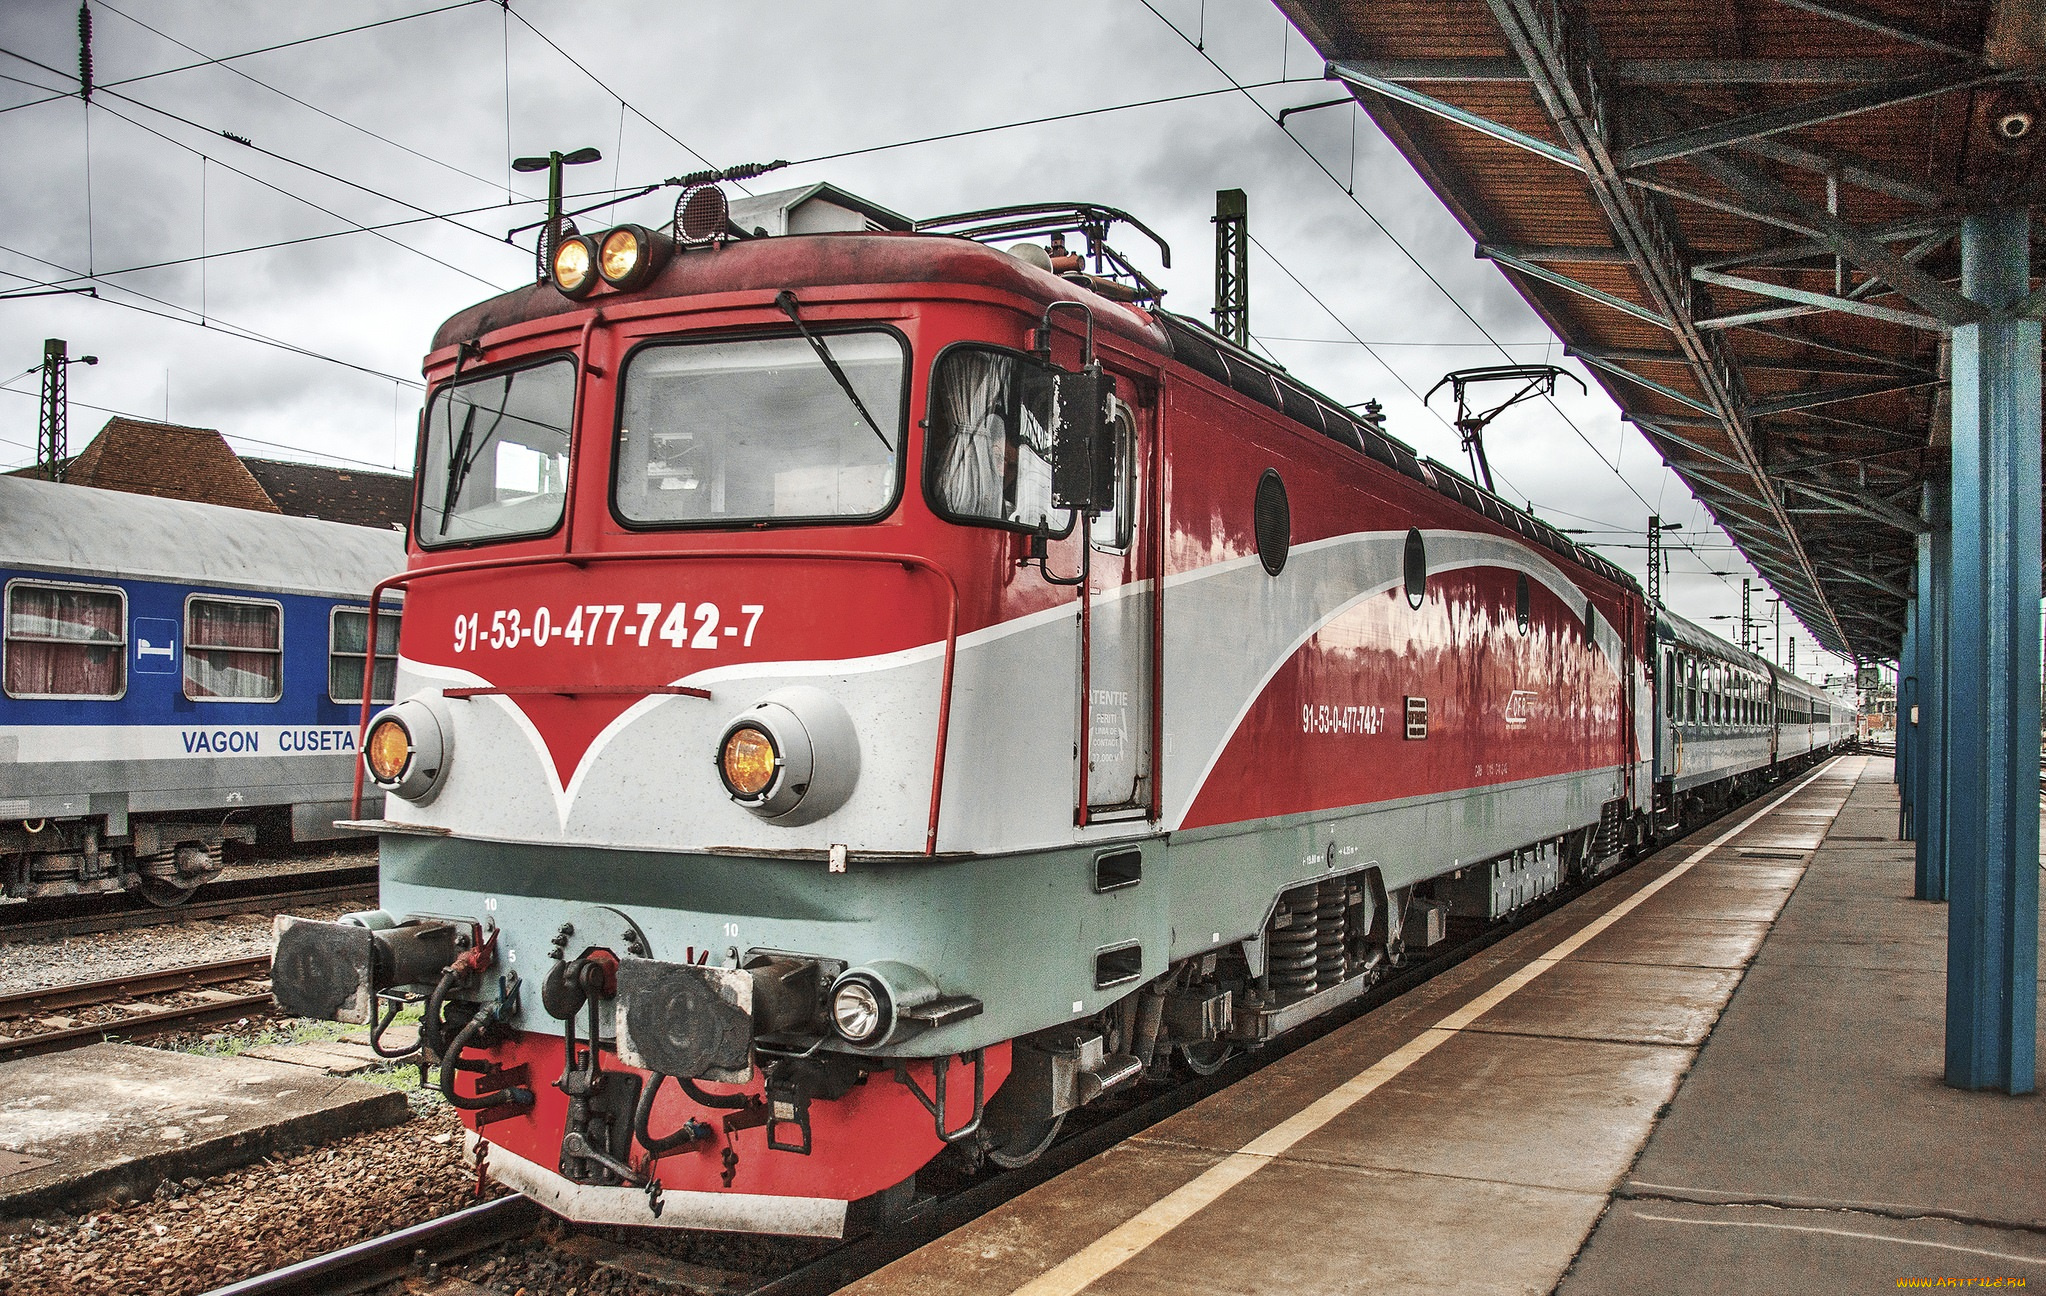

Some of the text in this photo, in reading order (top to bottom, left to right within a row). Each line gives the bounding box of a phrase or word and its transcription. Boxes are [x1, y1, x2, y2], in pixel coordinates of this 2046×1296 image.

[453, 602, 765, 653] 91-53-0-477-742-7
[1303, 703, 1384, 734] 91-53-0-477-742-7
[182, 730, 355, 753] VAGON CUSETA
[484, 898, 498, 911] 10
[723, 922, 739, 937] 10
[509, 950, 516, 963] 5
